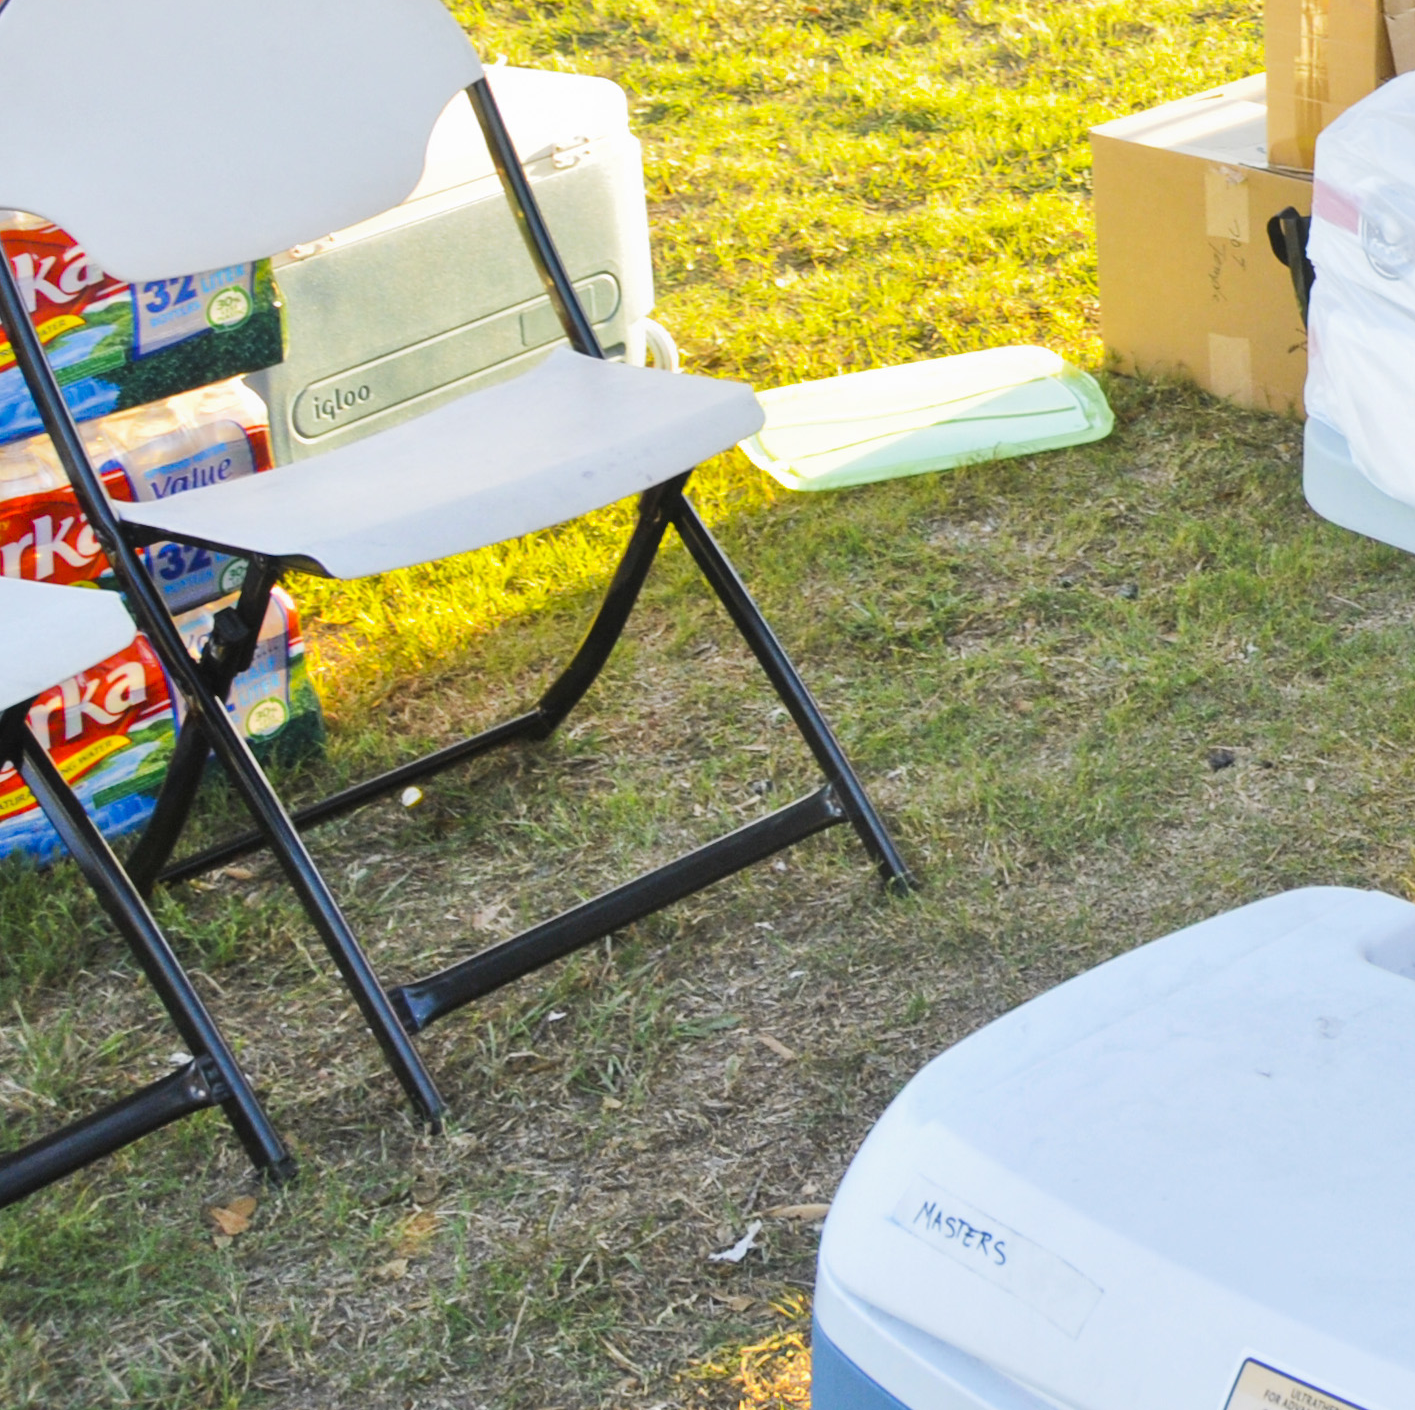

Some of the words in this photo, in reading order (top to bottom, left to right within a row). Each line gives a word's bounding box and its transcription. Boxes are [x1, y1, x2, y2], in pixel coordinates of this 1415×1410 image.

[144, 275, 198, 314] 32
[200, 264, 246, 294] LITER
[313, 385, 370, 420] igloo
[151, 458, 232, 501] Value
[0, 514, 100, 581] rka
[157, 542, 213, 582] 32
[28, 661, 148, 751] rka
[0, 790, 34, 811] ATURA
[913, 1201, 1006, 1266] MASTERS
[1264, 1389, 1282, 1405] FOR
